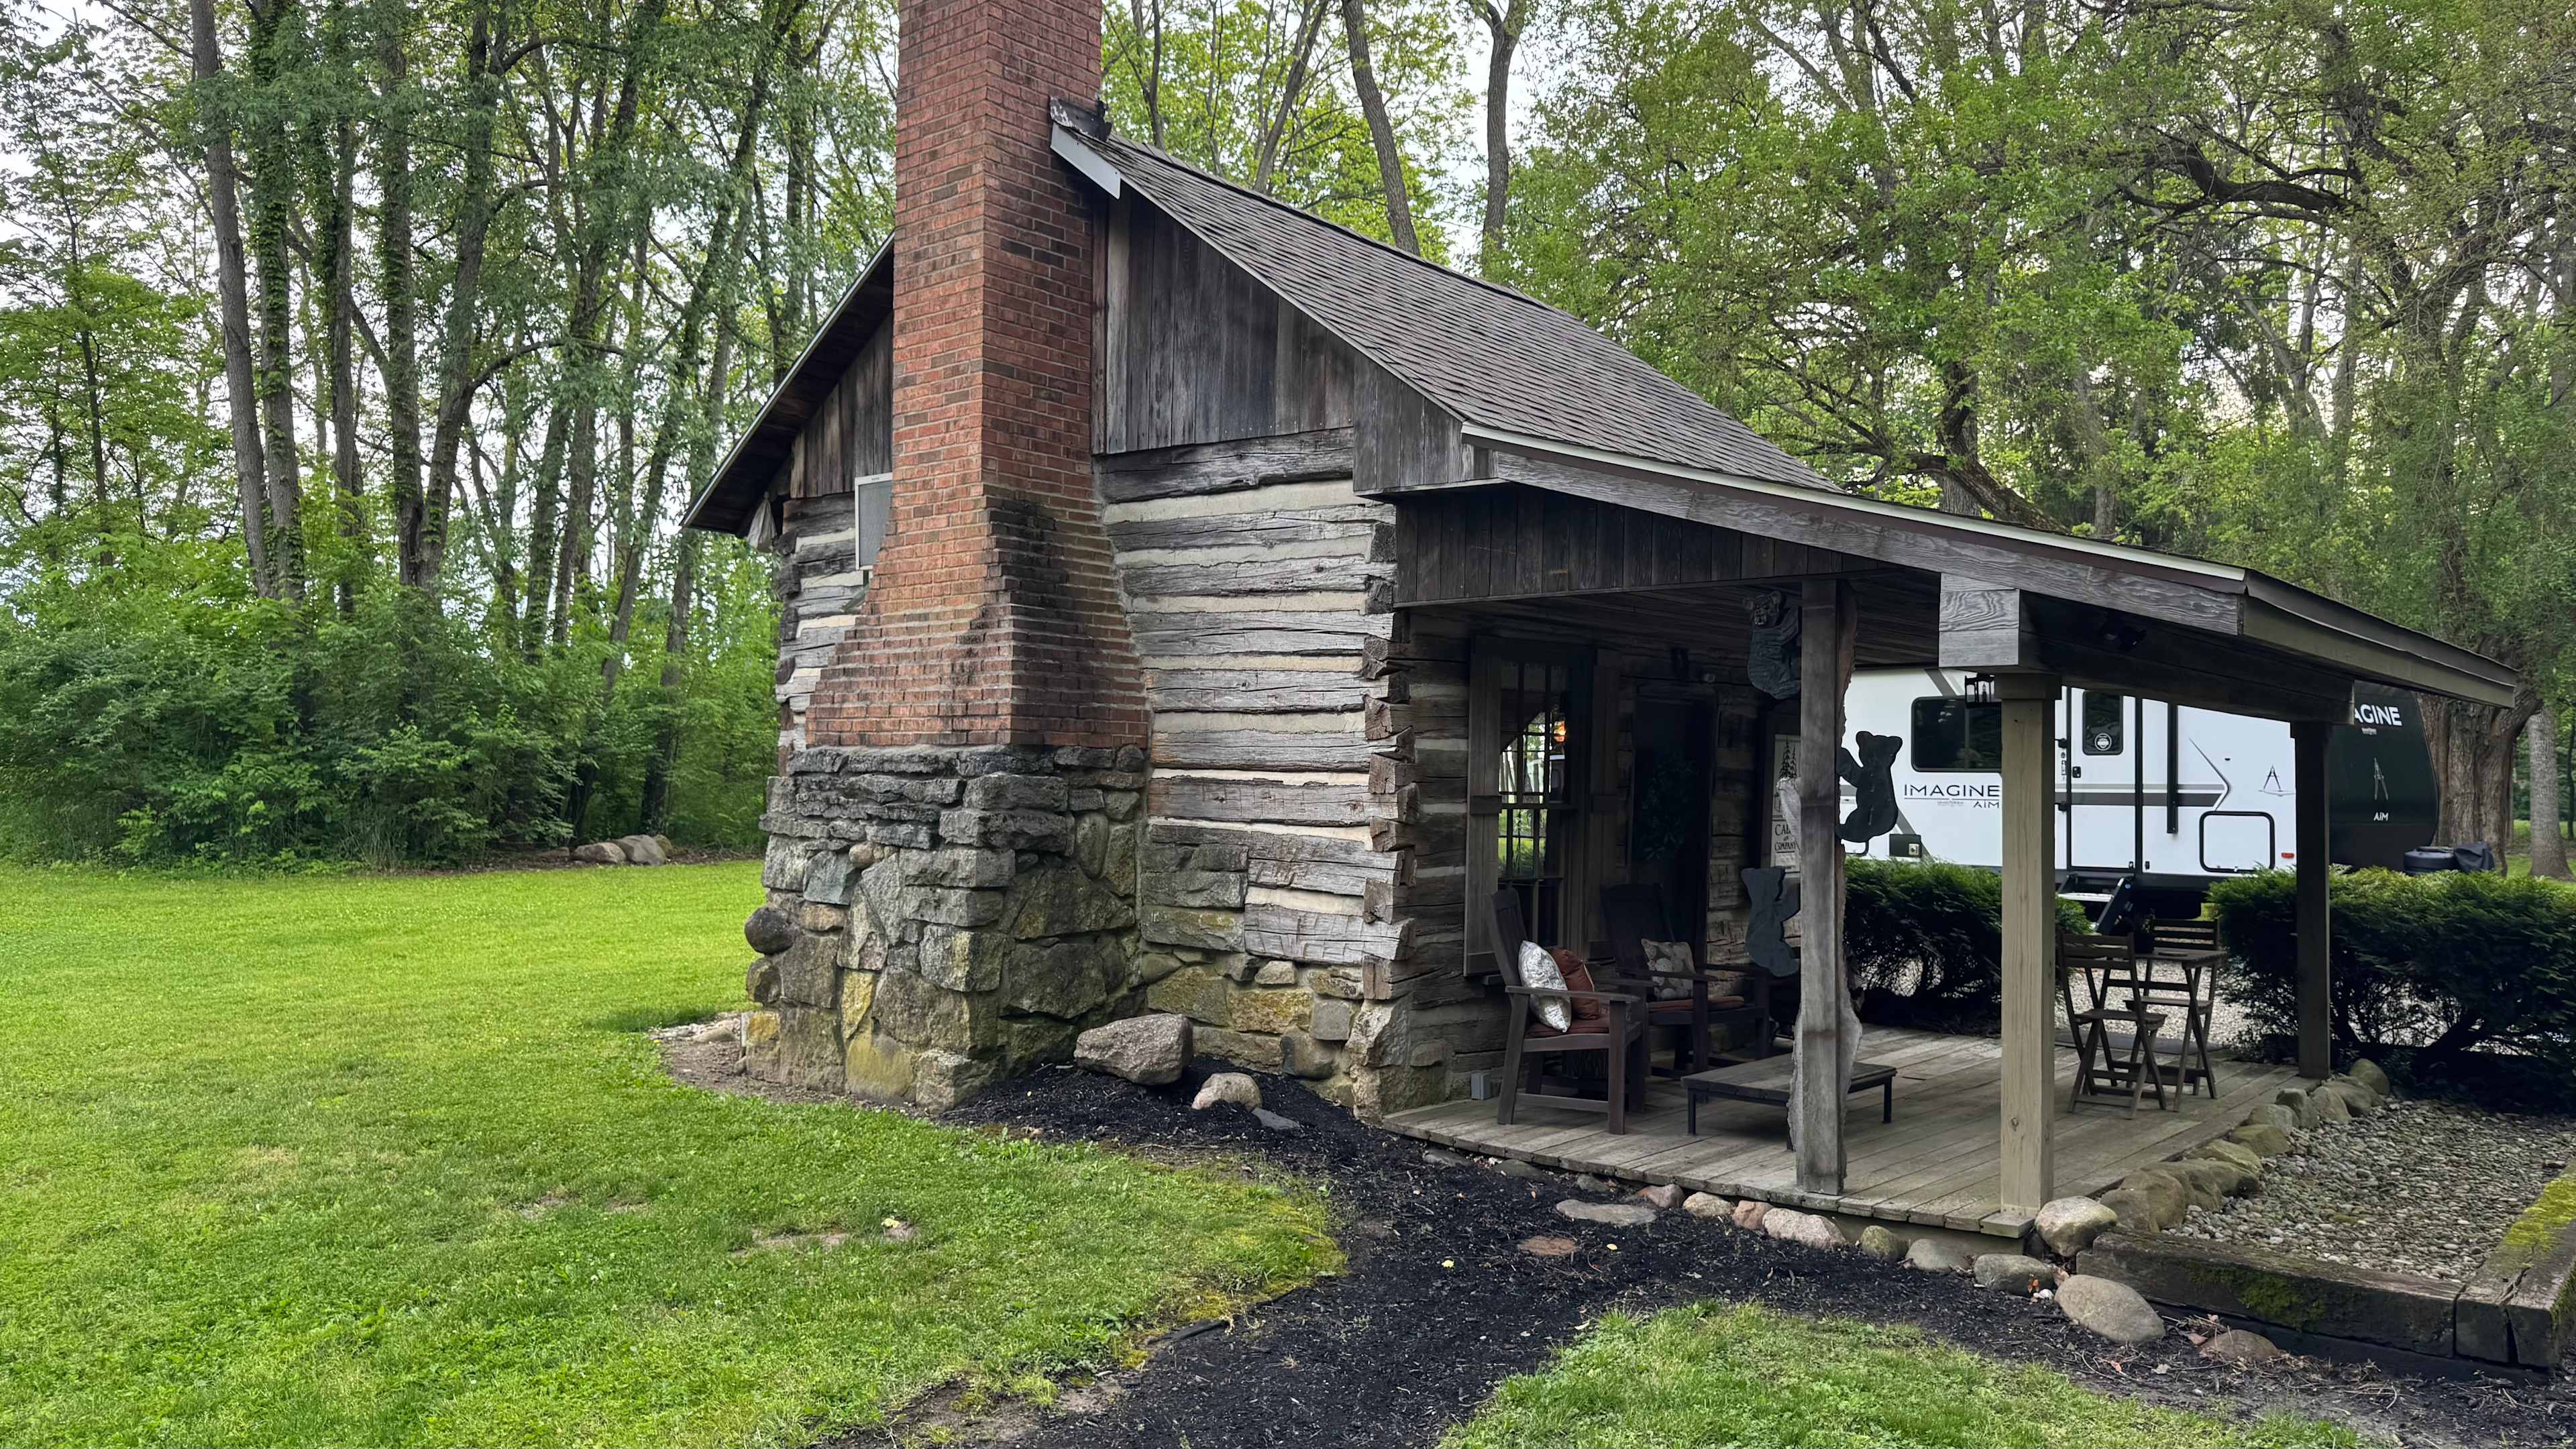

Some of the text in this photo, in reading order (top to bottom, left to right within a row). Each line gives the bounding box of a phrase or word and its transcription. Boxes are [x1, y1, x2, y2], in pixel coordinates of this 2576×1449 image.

[2355, 704, 2402, 726] AGINE
[1904, 784, 2000, 797] IMAGINE
[1973, 800, 2000, 808] AIM
